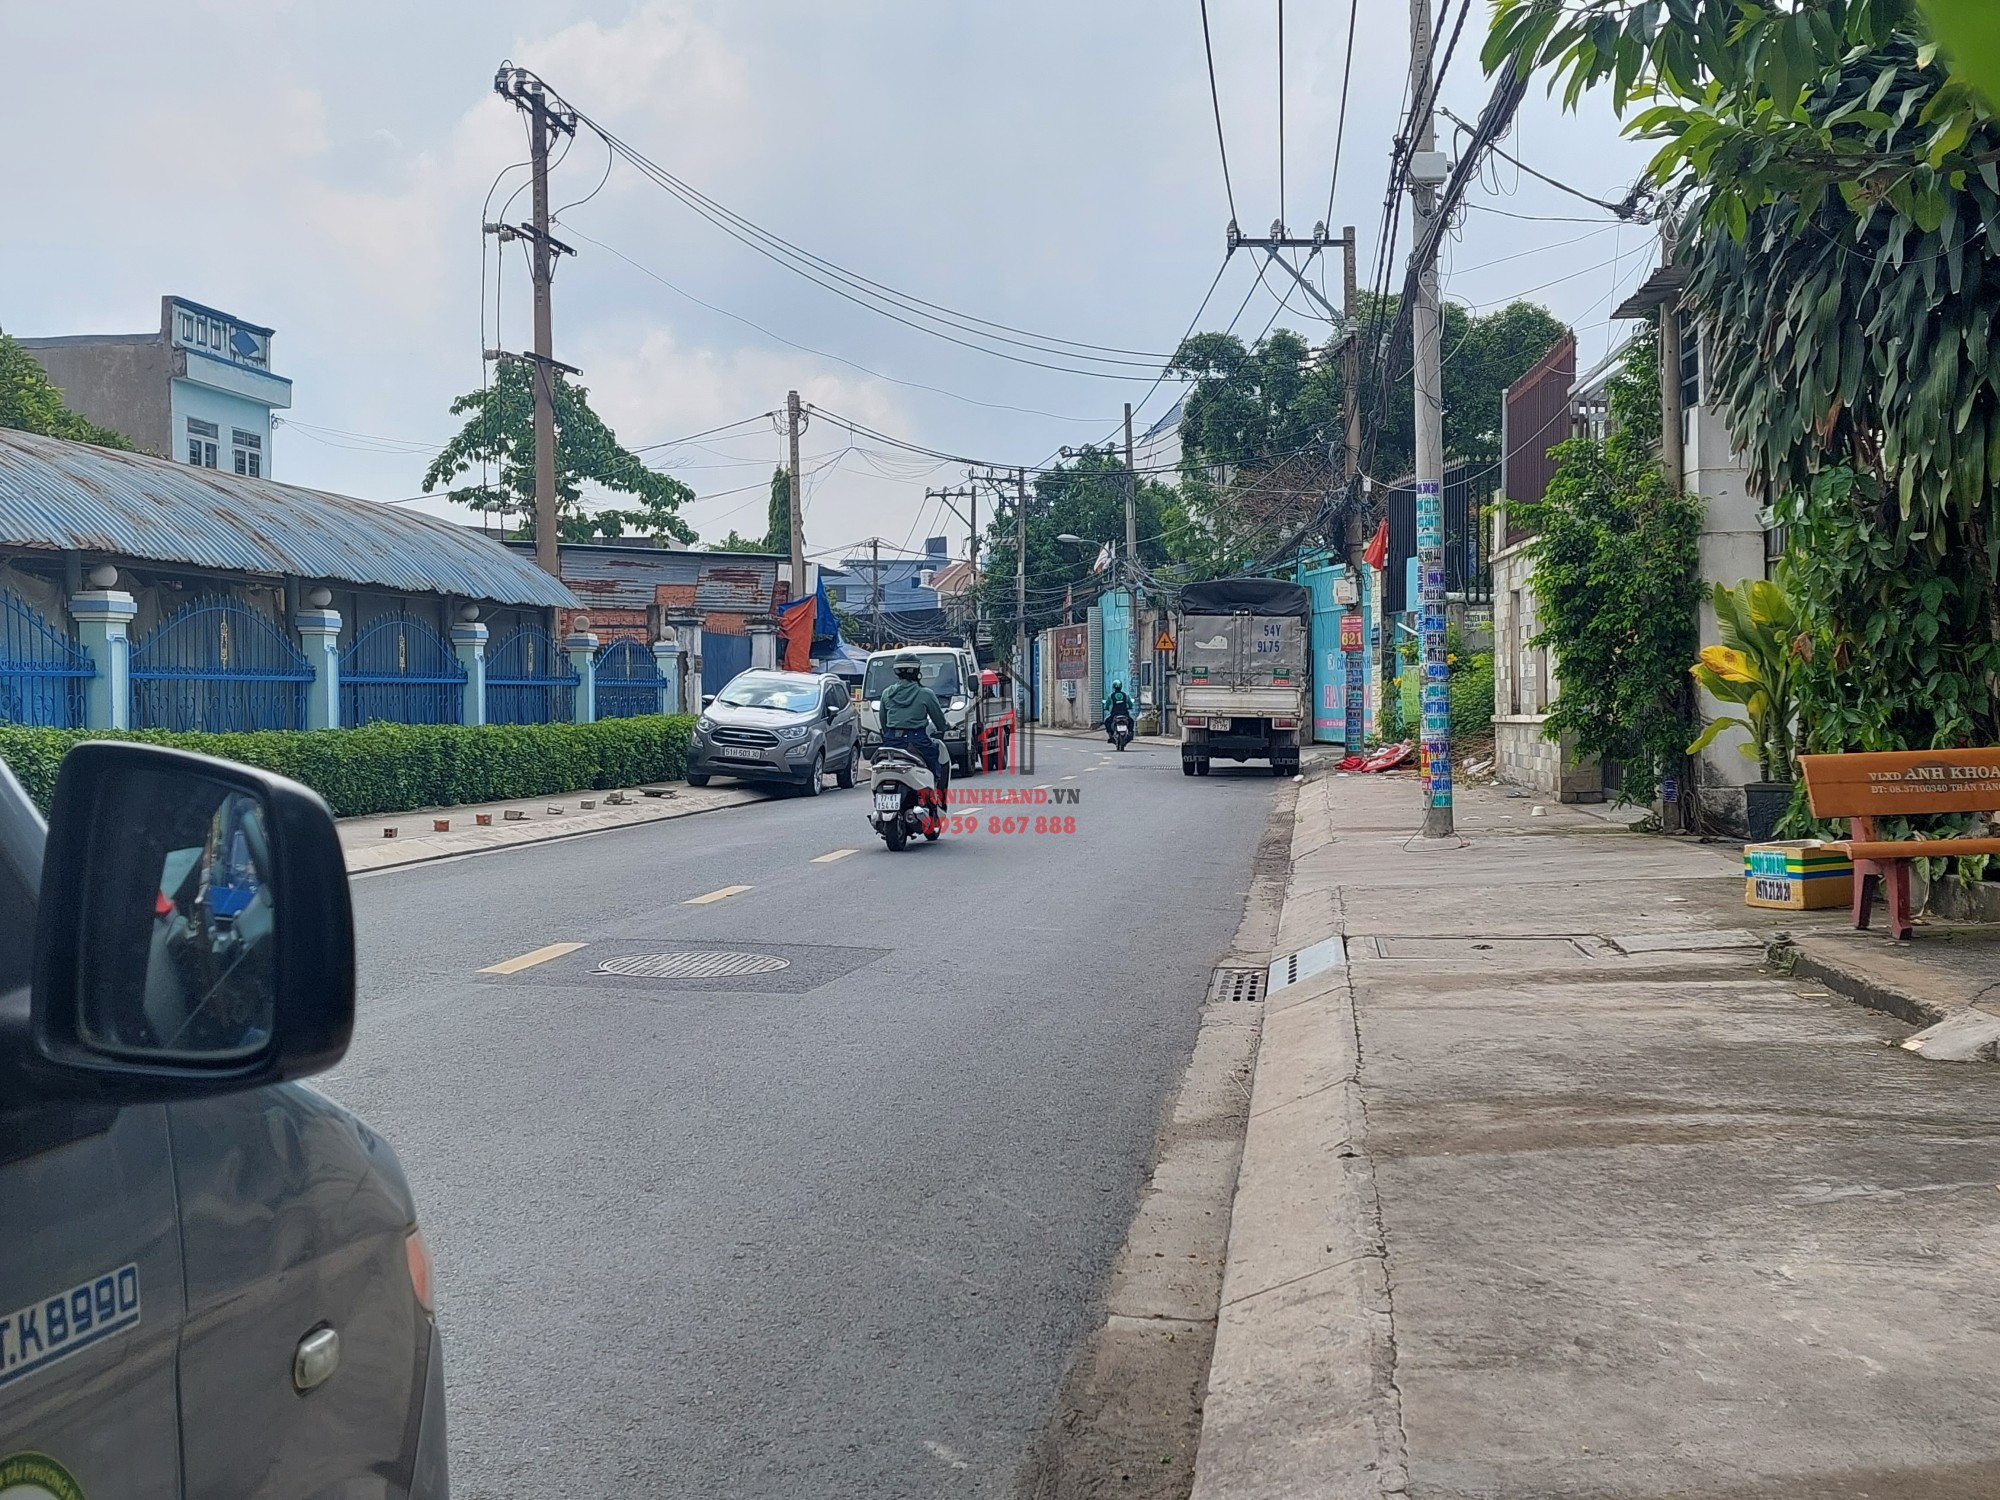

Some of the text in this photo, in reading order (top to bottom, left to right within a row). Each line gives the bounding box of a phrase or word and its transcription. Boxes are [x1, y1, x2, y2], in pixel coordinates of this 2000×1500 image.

[1264, 625, 1281, 637] 54Y
[1341, 632, 1362, 646] 621
[1258, 641, 1280, 652] 9175
[1868, 772, 1902, 781] VLXD
[1904, 767, 1945, 780] ANH
